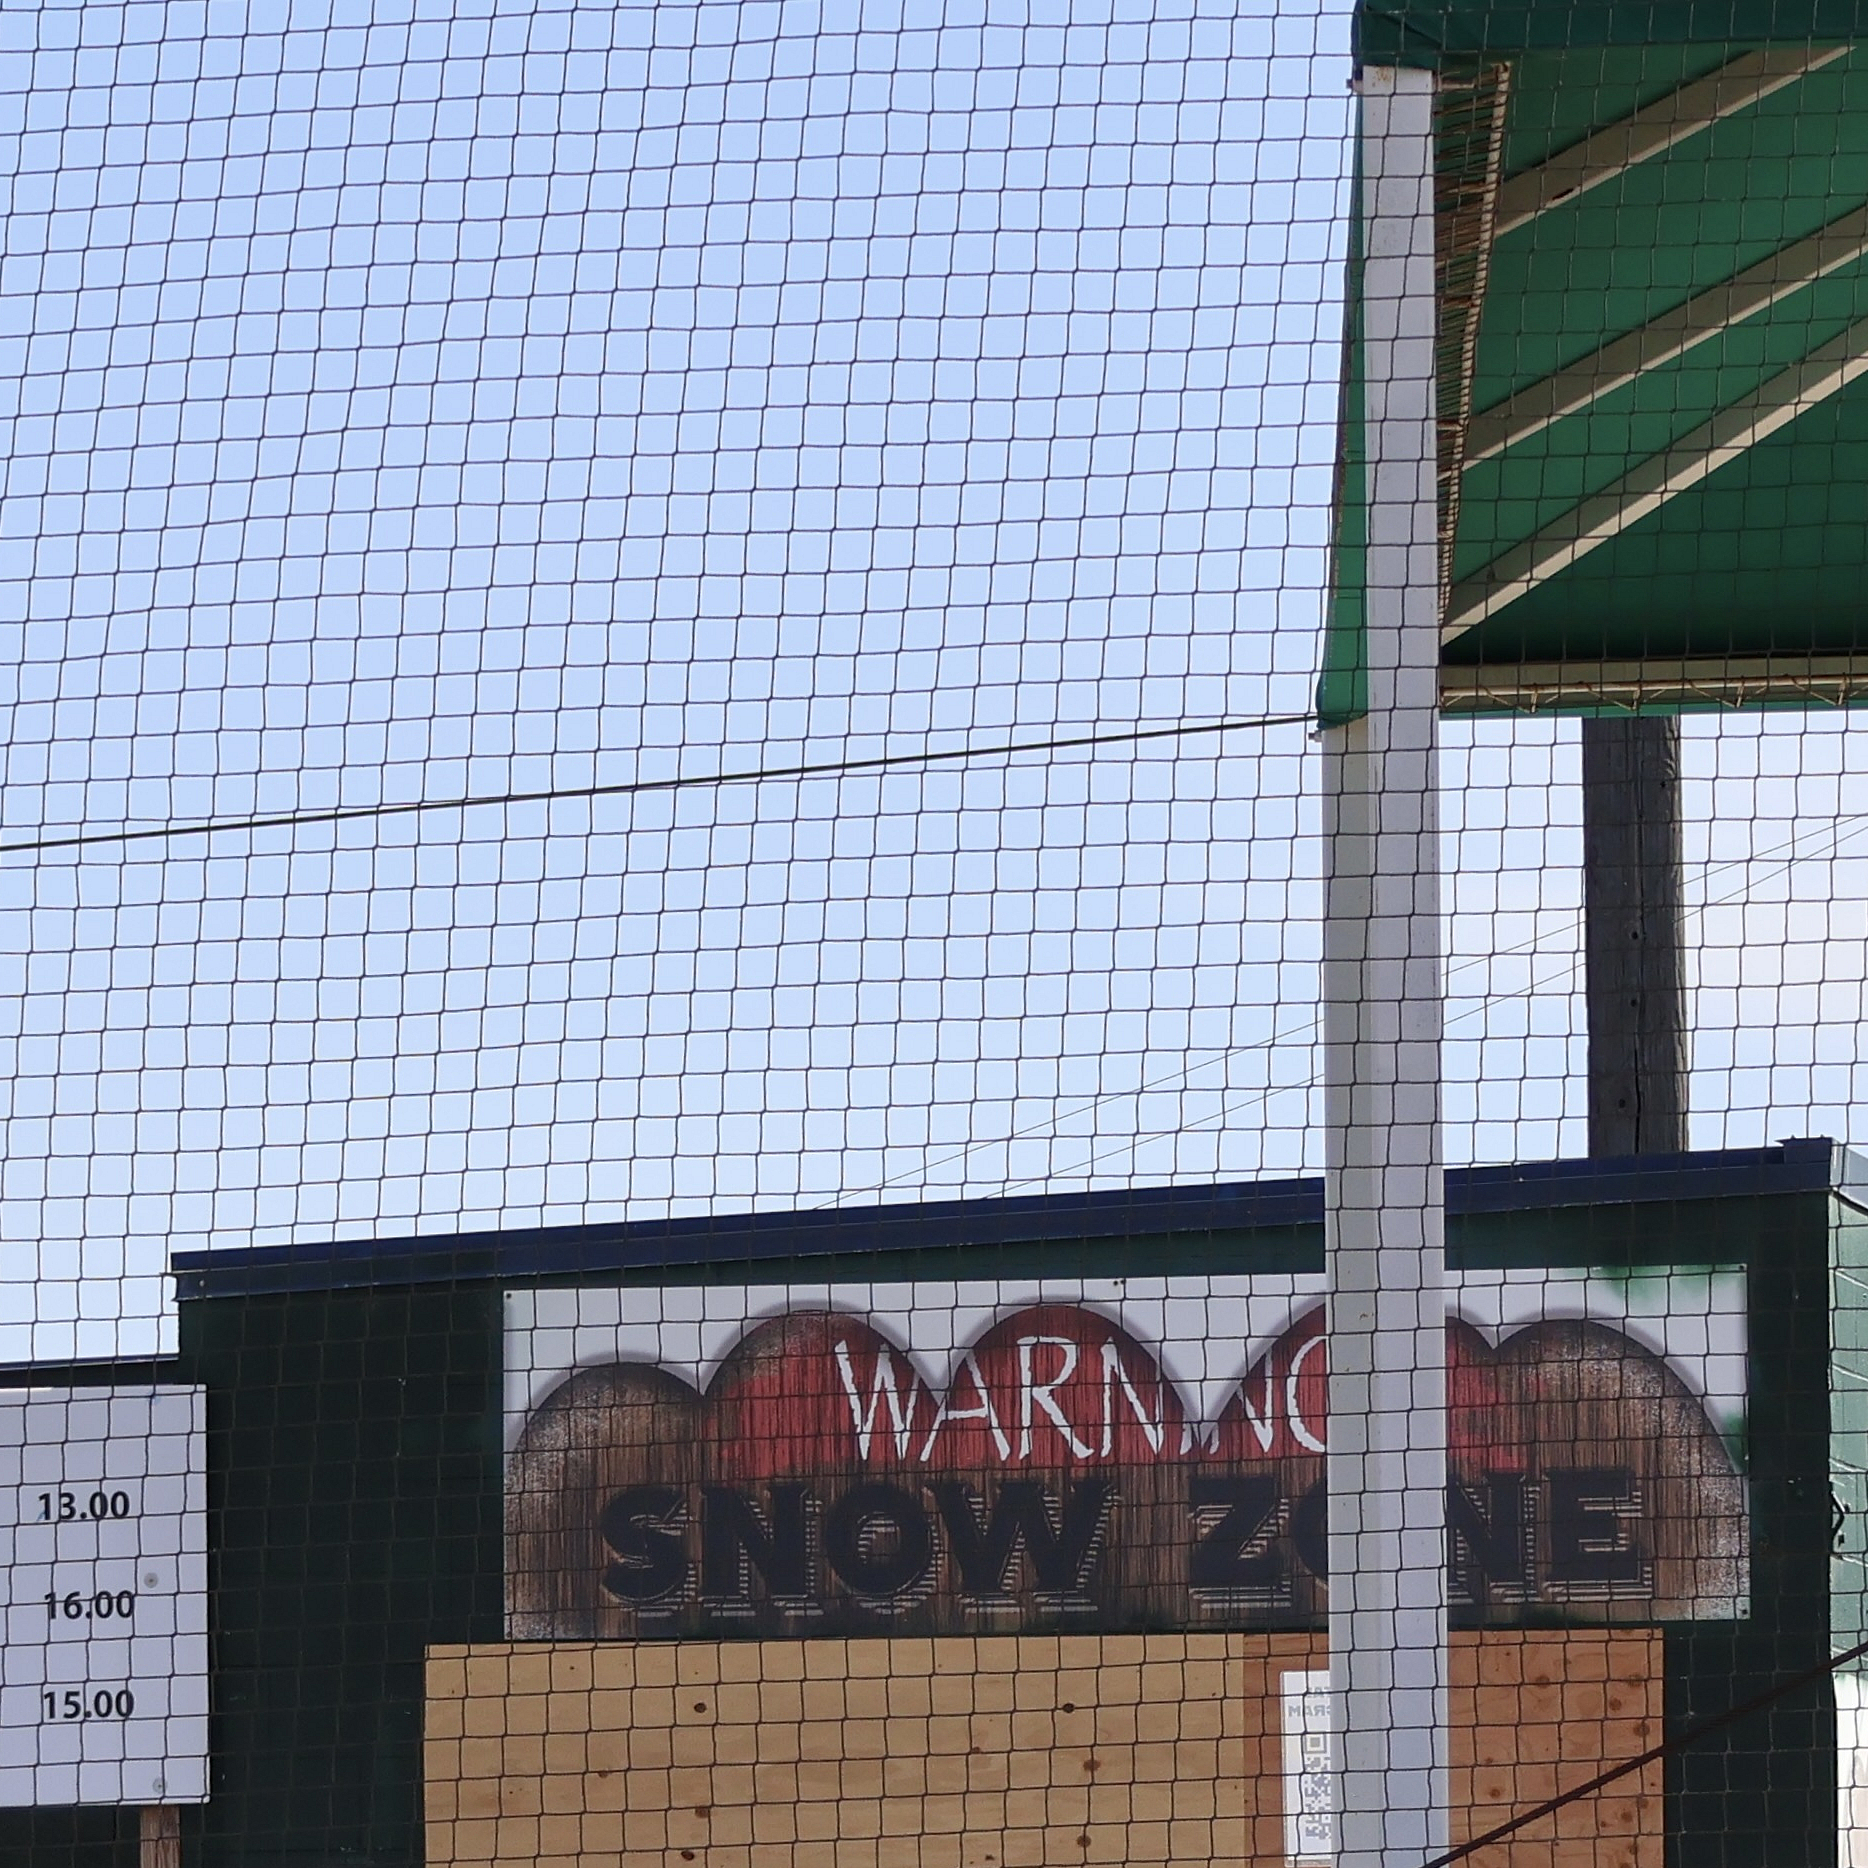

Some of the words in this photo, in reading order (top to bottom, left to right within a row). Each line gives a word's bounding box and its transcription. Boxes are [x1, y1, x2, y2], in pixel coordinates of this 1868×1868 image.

[39, 1490, 131, 1522] 13.00
[601, 1475, 1120, 1616] SNOW
[46, 1589, 135, 1621] 16.00
[42, 1688, 135, 1721] 15.00
